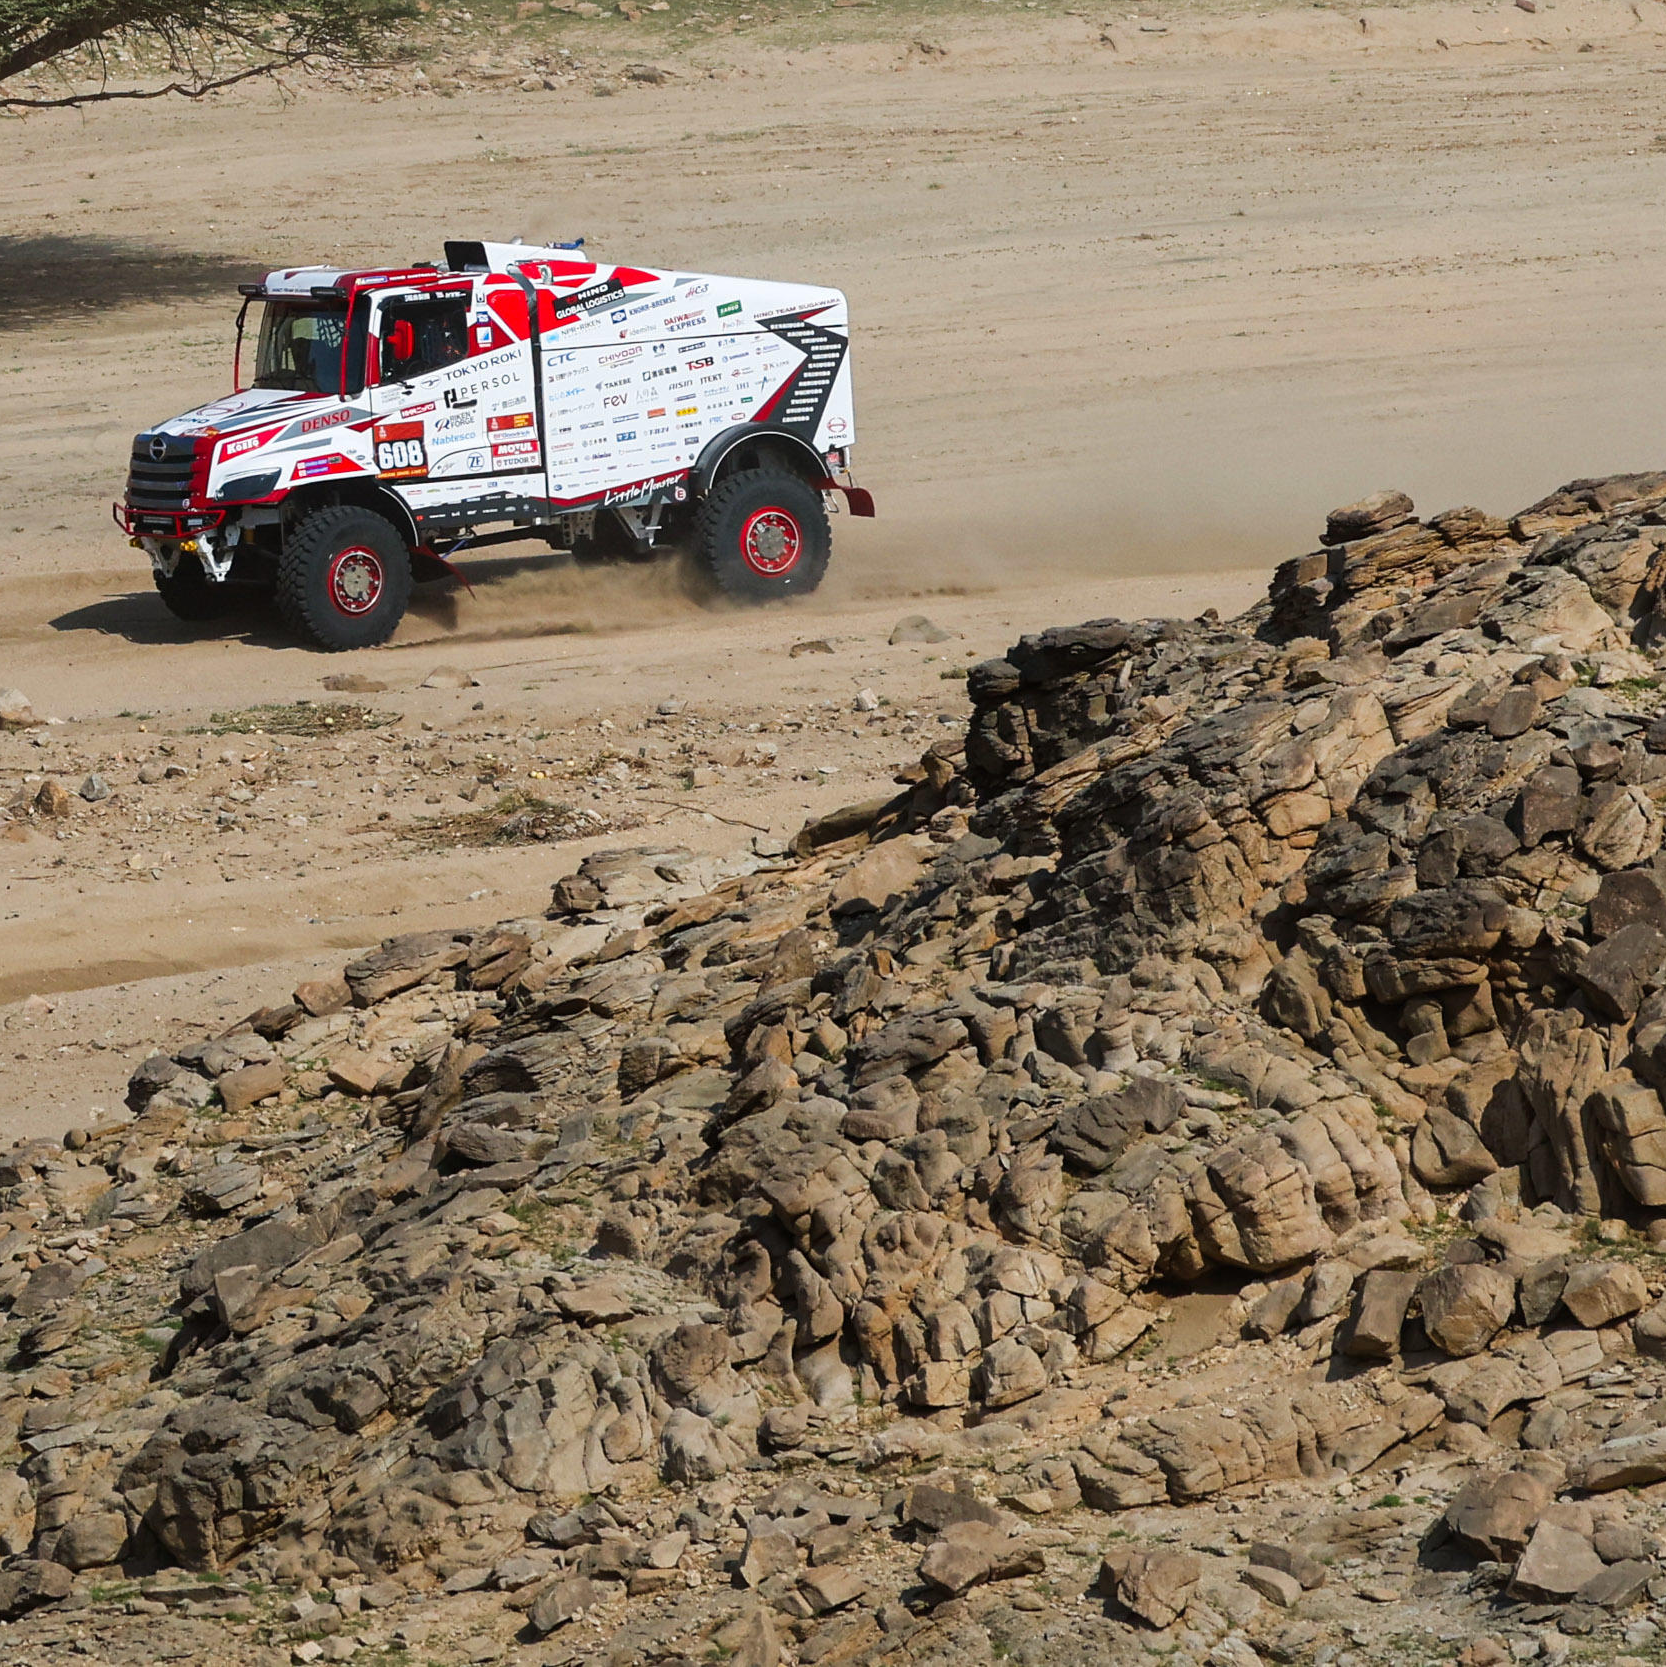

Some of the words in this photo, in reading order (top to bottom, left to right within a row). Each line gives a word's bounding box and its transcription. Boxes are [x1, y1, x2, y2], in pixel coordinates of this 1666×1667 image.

[578, 284, 609, 301] HINO
[556, 304, 585, 320] GLOBAL
[585, 289, 624, 310] LOGISTICS
[629, 295, 676, 315] KNORR-BREMSE
[754, 309, 774, 319] HINO
[776, 306, 796, 315] TEAM
[798, 297, 841, 310] SUGAWARA
[664, 313, 690, 326] DAIWA
[669, 316, 707, 332] EXPRESS
[547, 351, 576, 367] CTC
[598, 345, 643, 364] CHIYODA
[444, 360, 489, 381] TOKYO
[490, 349, 522, 366] ROKI
[685, 356, 715, 372] TSB
[460, 372, 521, 398] PERSOL
[604, 377, 631, 389] TAKEBE
[301, 409, 351, 433] DENSO
[449, 411, 471, 421] RIKEN
[450, 419, 475, 428] FORGE
[431, 432, 476, 446] Nabtesco
[378, 440, 423, 469] 608
[497, 442, 533, 455] MOTUL
[504, 457, 529, 466] TUDOR
